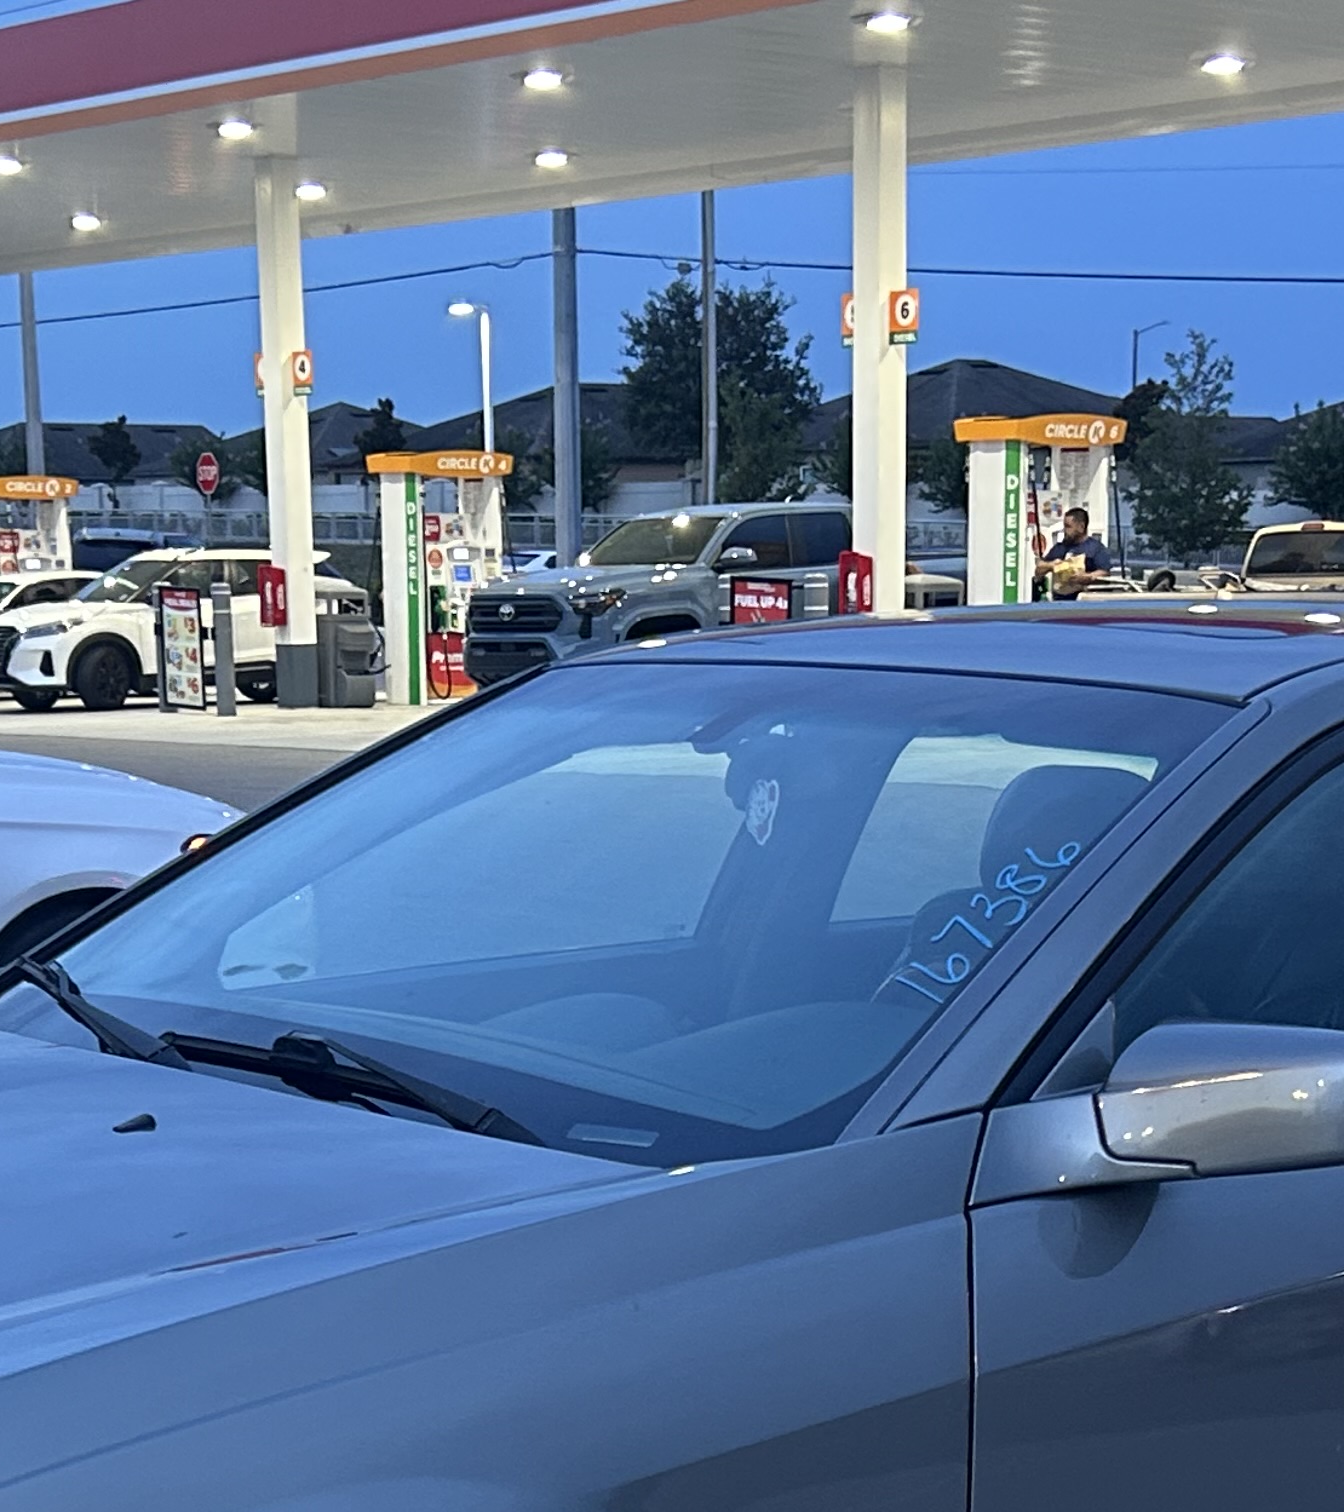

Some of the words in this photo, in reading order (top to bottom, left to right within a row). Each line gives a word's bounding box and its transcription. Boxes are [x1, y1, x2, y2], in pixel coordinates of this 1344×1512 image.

[900, 301, 910, 320] 6
[298, 359, 306, 374] 4
[1045, 423, 1088, 439] CIRCLE
[1088, 420, 1105, 444] K
[1109, 425, 1119, 438] 6
[199, 465, 217, 481] STOP
[437, 457, 477, 470] CIRCLE
[479, 454, 495, 473] K
[498, 459, 507, 470] 4
[1006, 474, 1019, 587] DIESEL
[407, 502, 419, 595] DIESEL
[734, 594, 759, 608] FUEL
[760, 596, 775, 608] UP
[895, 841, 1081, 1004] 167386
